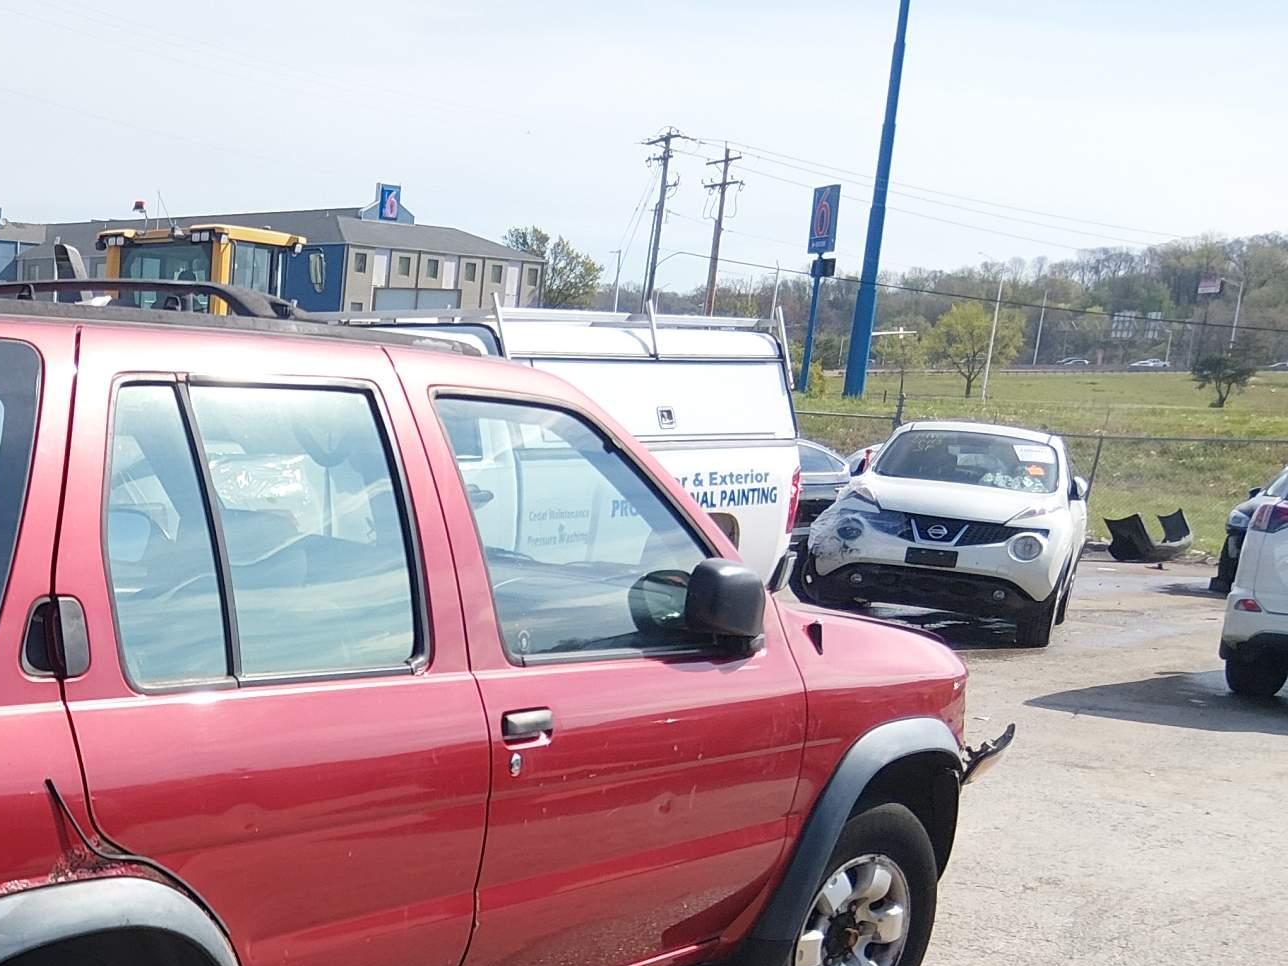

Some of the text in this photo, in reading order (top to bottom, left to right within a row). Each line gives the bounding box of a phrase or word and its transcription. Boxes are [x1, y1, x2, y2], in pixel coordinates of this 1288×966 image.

[814, 188, 830, 237] 6
[692, 472, 703, 487] &
[709, 468, 770, 486] Exterior
[720, 486, 777, 507] PAINTING
